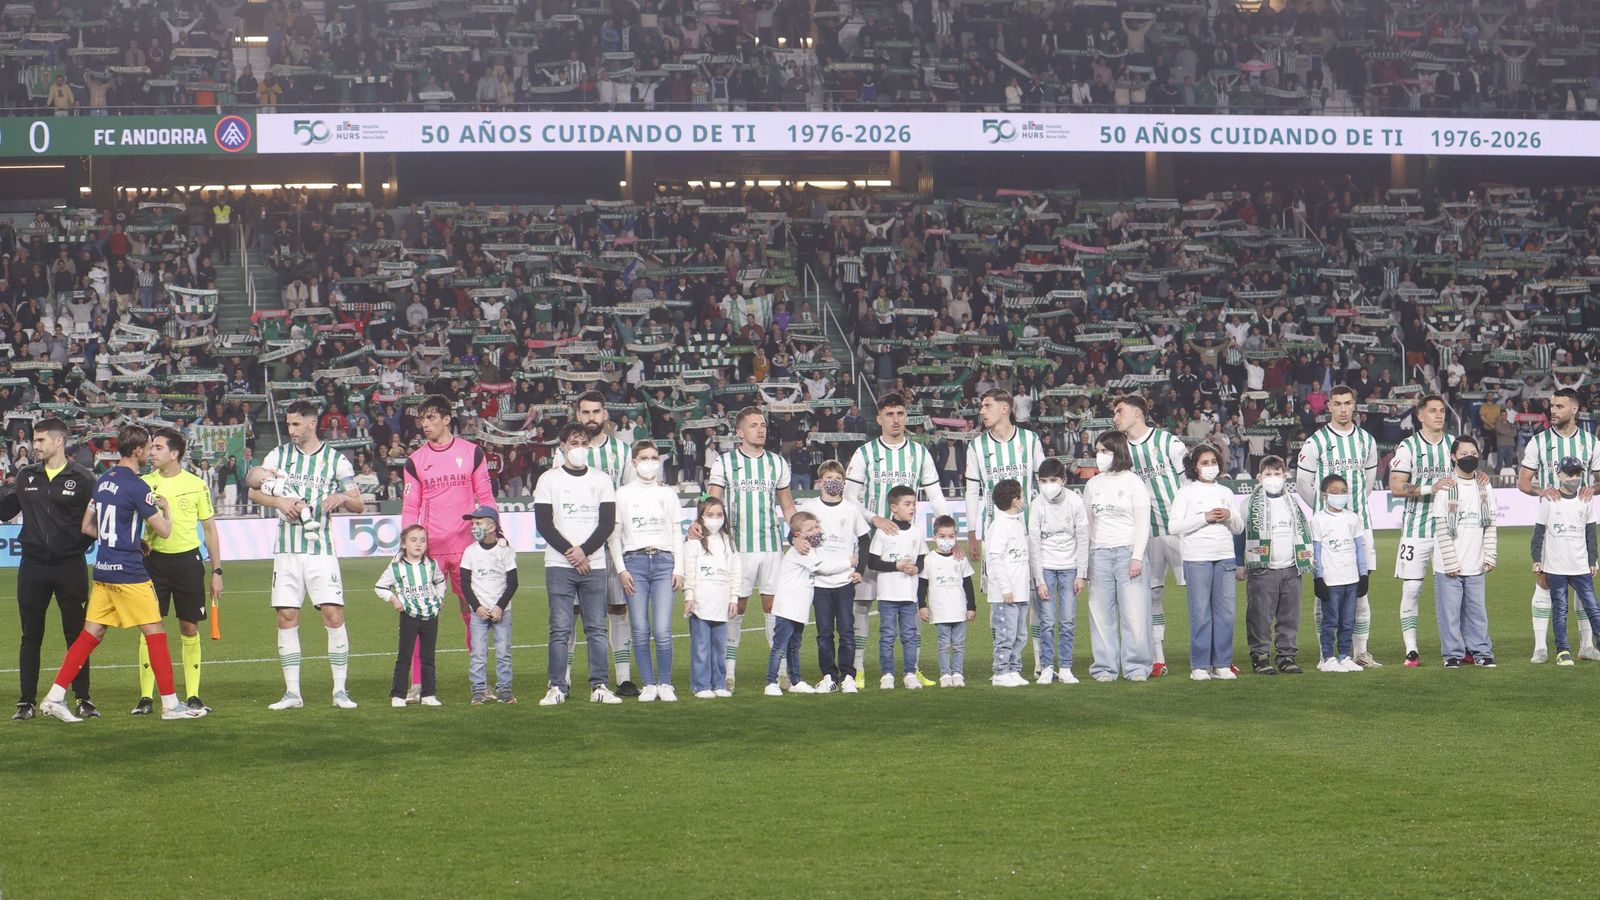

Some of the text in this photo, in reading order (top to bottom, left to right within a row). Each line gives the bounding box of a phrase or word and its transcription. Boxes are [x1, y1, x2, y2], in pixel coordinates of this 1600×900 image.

[29, 120, 50, 153] 0
[94, 128, 208, 146] FC ANDORRA
[336, 132, 360, 140] HURS
[421, 120, 911, 144] 50 AÑOS CUIDANDO DE TI 1976-2026
[1100, 122, 1541, 149] 50 AÑOS CUIDANDO DE TI 1976-2026
[874, 471, 916, 479] BAHRAIN
[987, 464, 1028, 475] BAHRAIN
[424, 474, 467, 486] BAHRAIN
[734, 479, 775, 487] BAHRAIN
[95, 502, 118, 548] 14
[349, 519, 400, 556] 50
[1400, 544, 1415, 561] 23
[95, 561, 123, 571] Andorra
